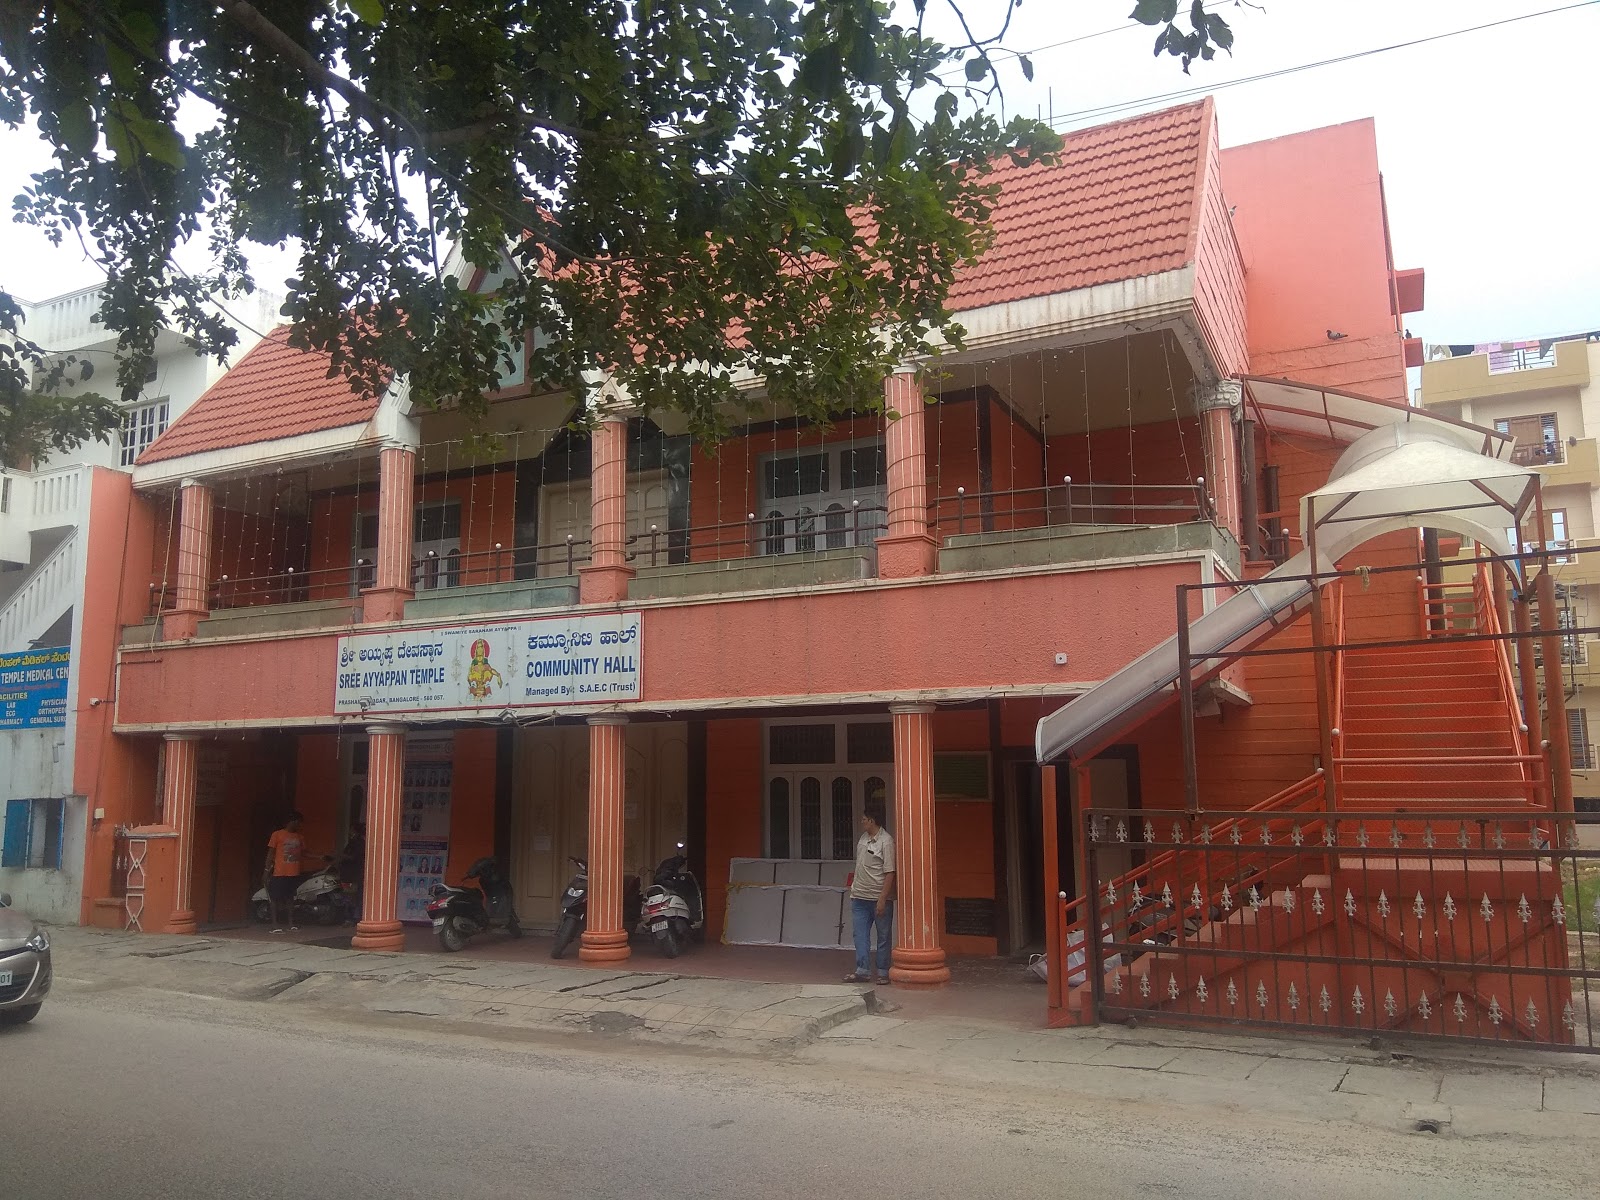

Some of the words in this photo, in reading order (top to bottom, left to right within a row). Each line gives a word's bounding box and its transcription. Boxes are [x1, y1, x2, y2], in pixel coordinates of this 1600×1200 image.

[599, 625, 637, 645] ಹಾಲ್
[341, 646, 356, 667] ಶ್ರೀ
[359, 646, 393, 666] ಅಯ್ಯಪ್ಪ
[397, 641, 443, 663] ದೇವಸ್ಥಾನ
[1, 671, 25, 684] TEMPLE
[26, 669, 54, 681] MEDICAL
[526, 657, 600, 678] COMMUNITY
[603, 655, 636, 674] HALL
[339, 673, 361, 689] SREE
[362, 669, 408, 688] AYYAPPAN
[409, 667, 445, 685] TEMPLE
[525, 685, 559, 697] Managed
[579, 683, 608, 693] S.A.E.C
[609, 682, 636, 693] (Trust)
